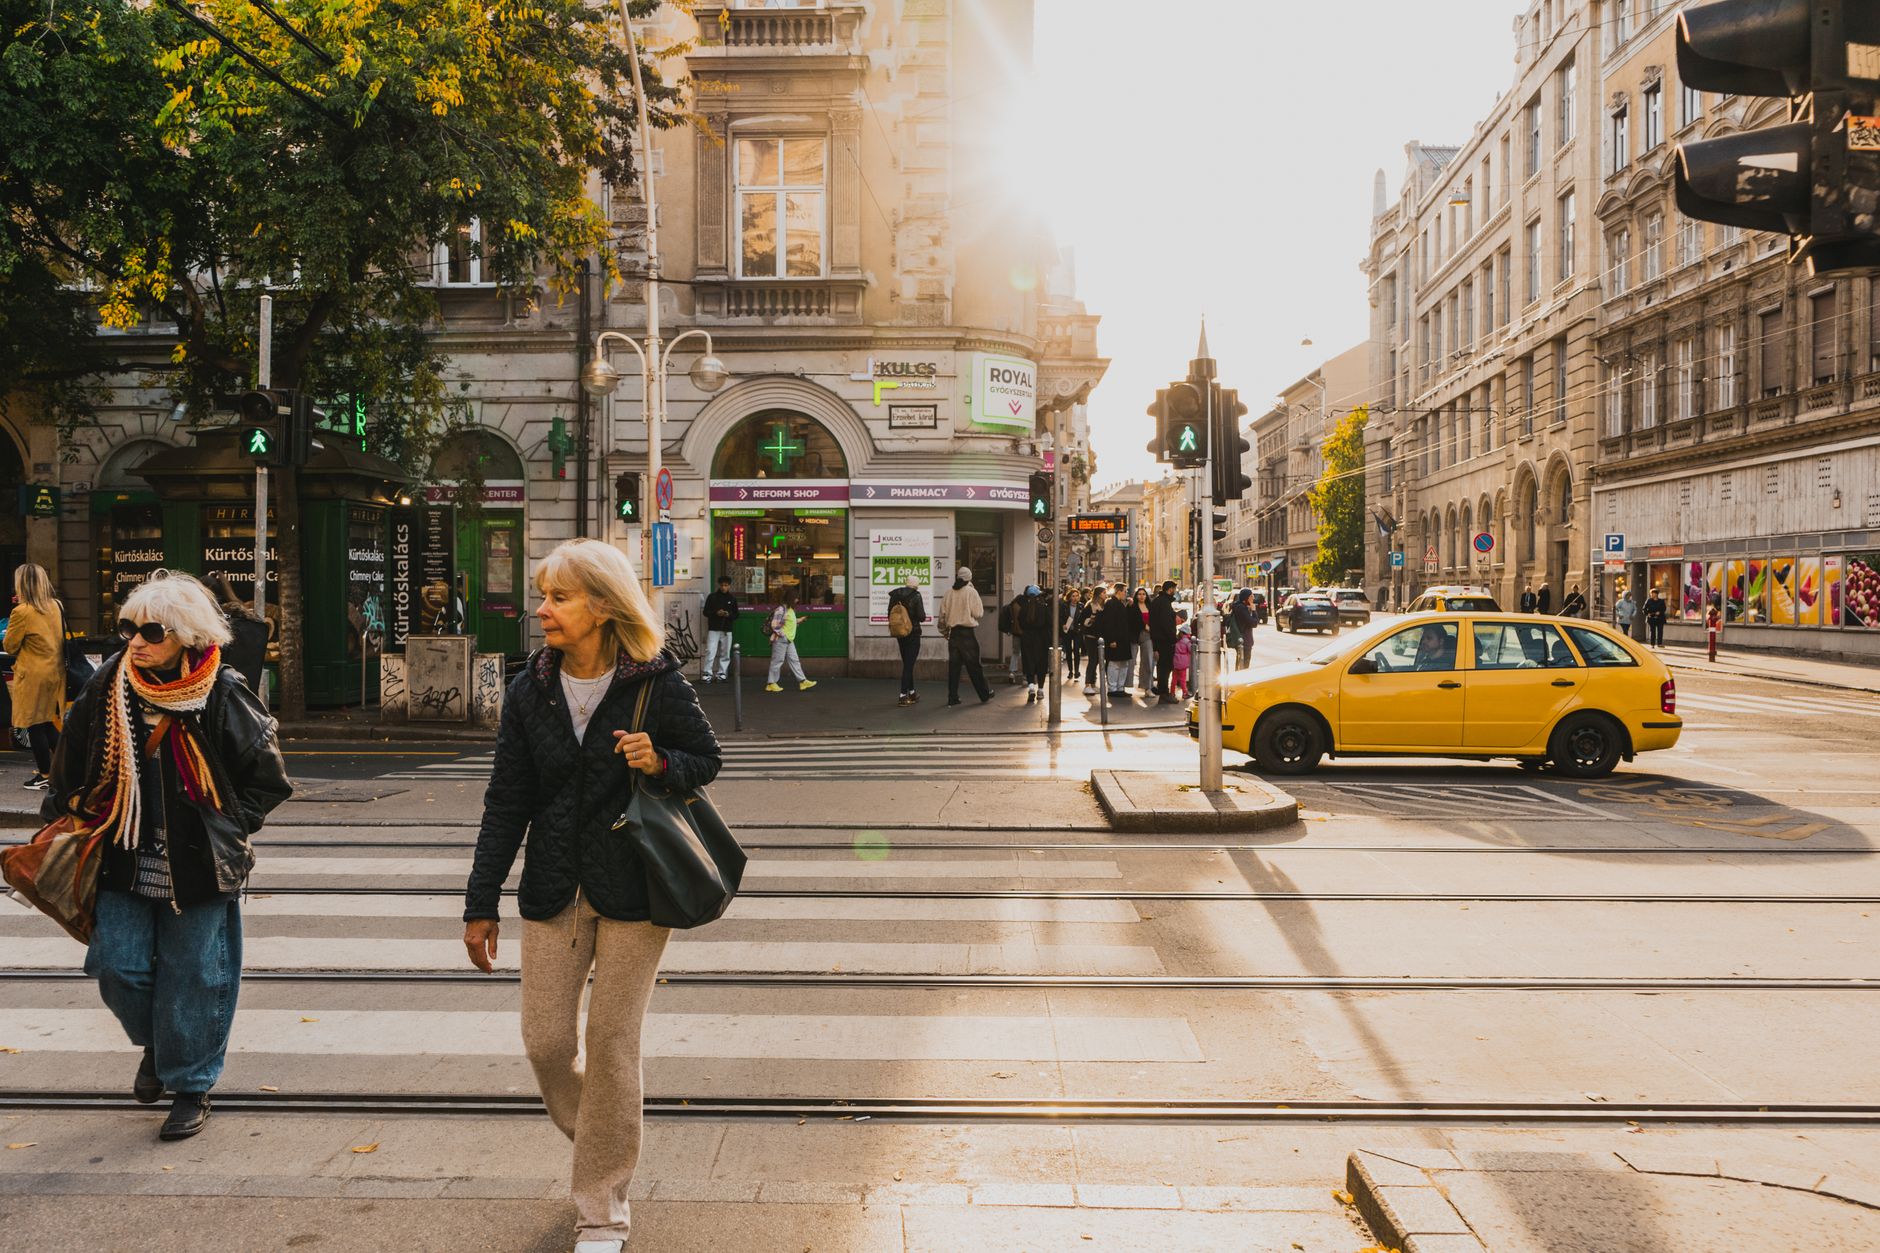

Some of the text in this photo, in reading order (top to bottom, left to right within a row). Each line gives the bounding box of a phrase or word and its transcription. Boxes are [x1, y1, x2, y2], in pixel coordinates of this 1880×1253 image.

[880, 362, 936, 375] KULCS
[990, 367, 1032, 388] ROYAL
[483, 490, 517, 498] ENTER
[753, 489, 819, 498] REFORM SHOP
[890, 487, 948, 497] PHARMACY
[989, 487, 1030, 500] GYÓGYSZE
[216, 509, 274, 519] HIRA
[1609, 536, 1620, 551] P
[114, 549, 164, 563] Kürtőskalács
[205, 547, 278, 561] Kürtősal
[1393, 553, 1402, 565] P
[116, 571, 146, 584] Chimney
[350, 570, 384, 584] Chimney Cake
[874, 567, 895, 583] 21
[898, 566, 929, 576] ÓRÁIG
[393, 524, 409, 645] Kürtőskalács
